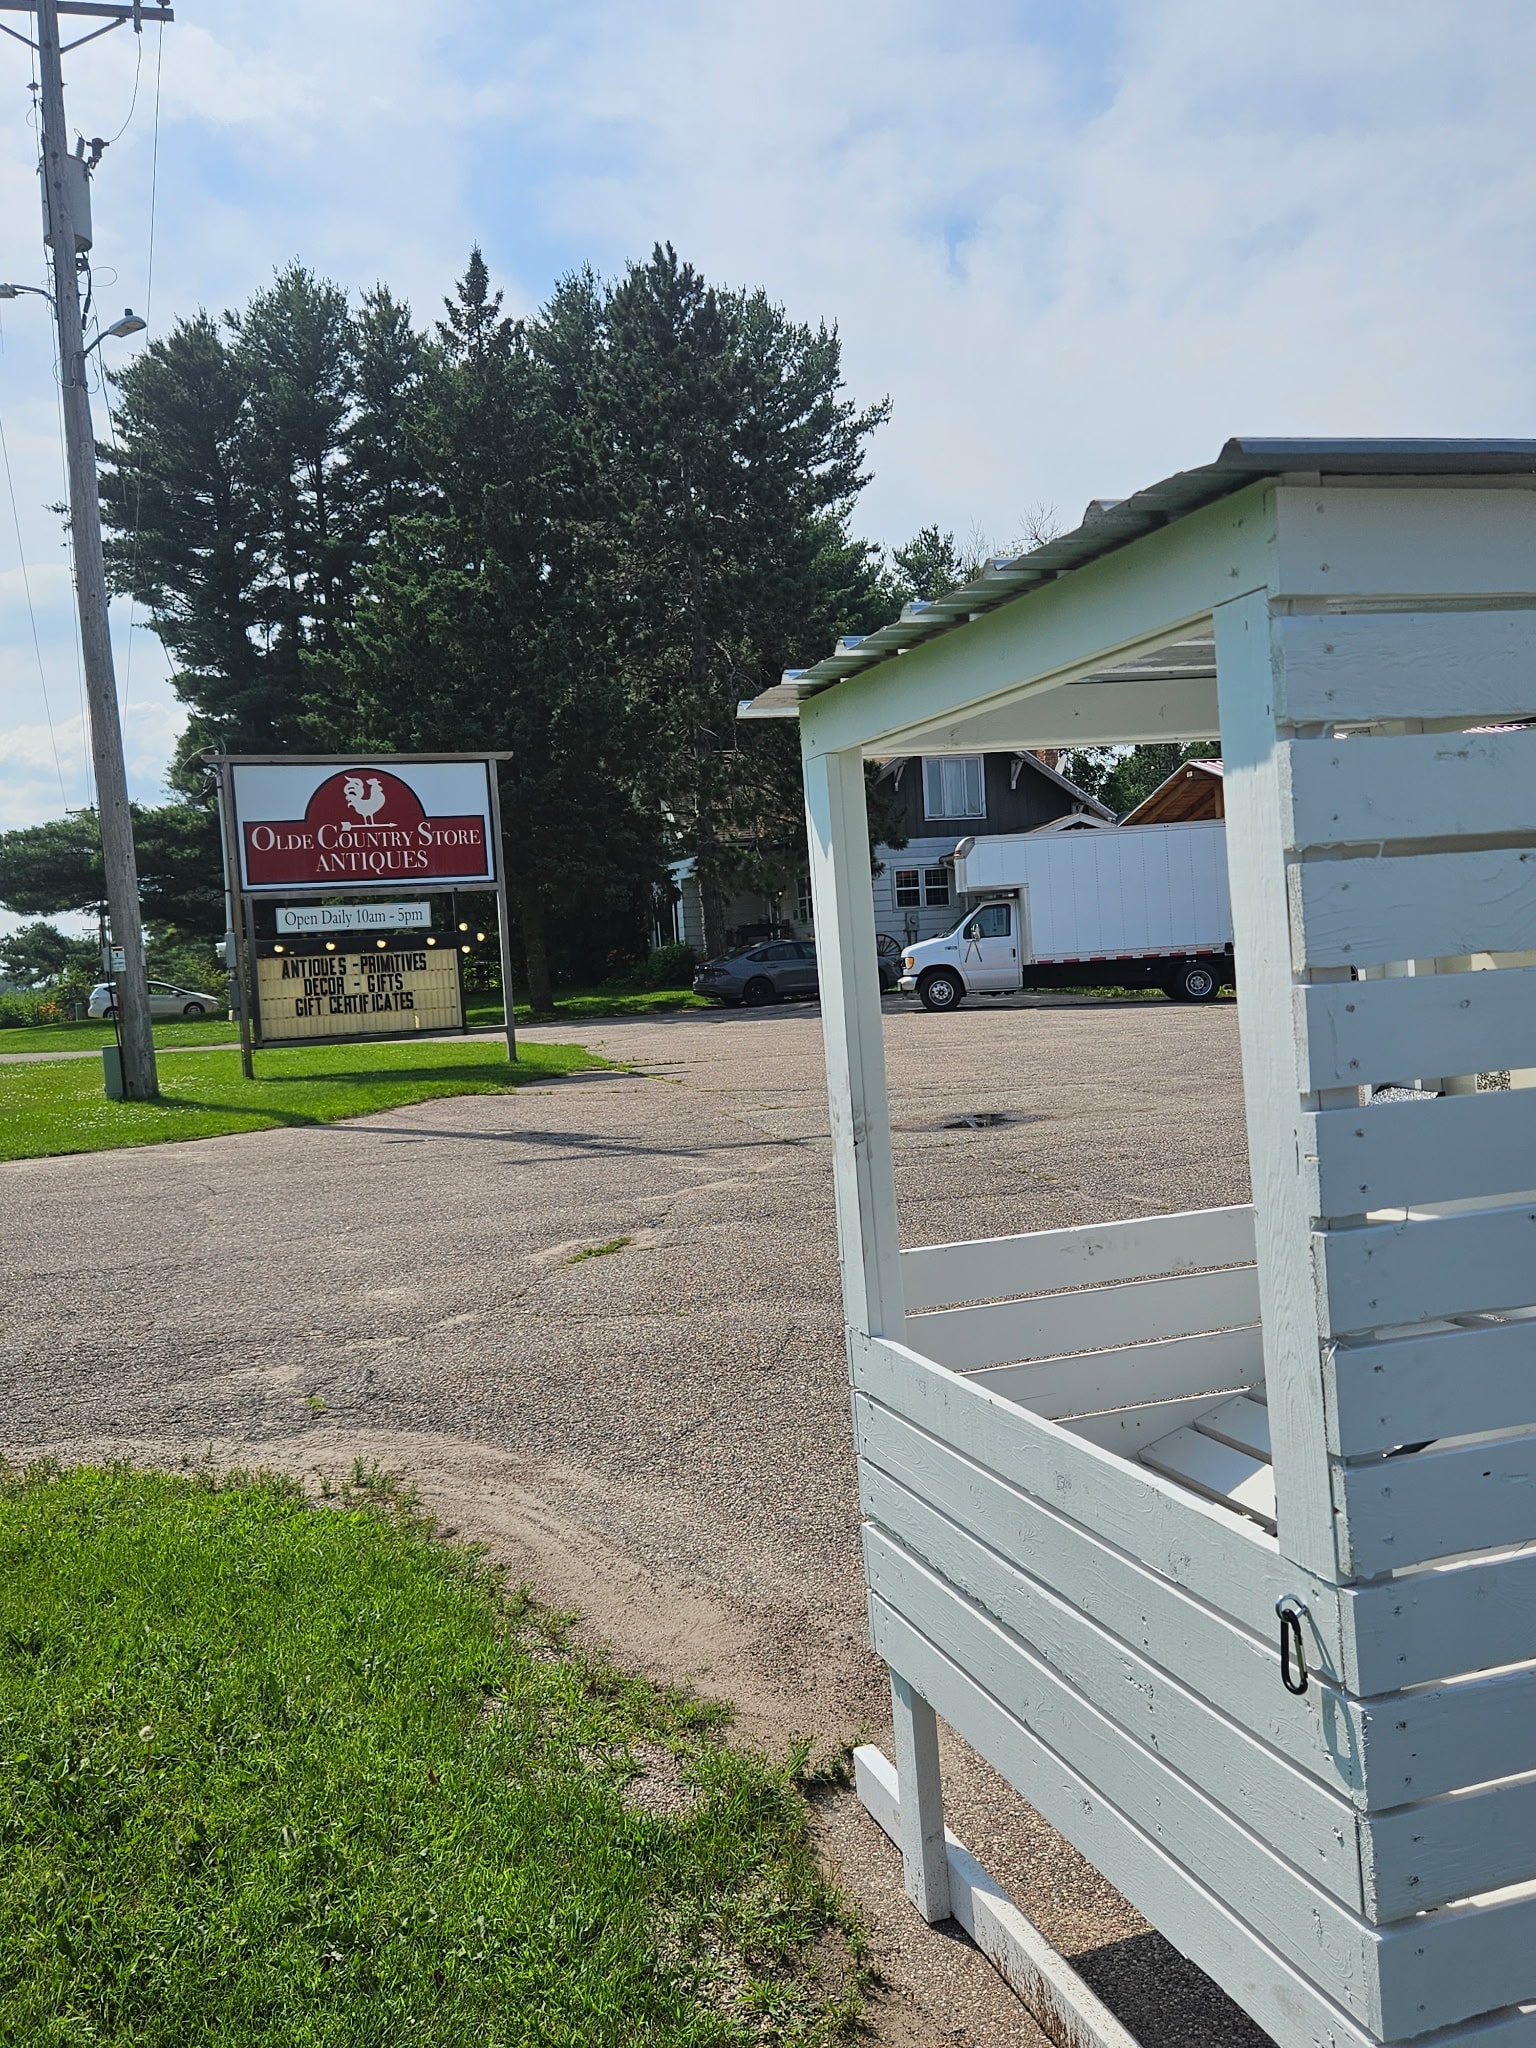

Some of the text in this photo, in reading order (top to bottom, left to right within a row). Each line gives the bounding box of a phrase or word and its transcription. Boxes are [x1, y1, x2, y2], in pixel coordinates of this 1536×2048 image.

[317, 824, 415, 850] COUNTRY
[417, 821, 481, 847] STORE
[316, 850, 428, 874] ANTIQUES
[284, 911, 318, 929] Open
[321, 909, 352, 927] Daily
[356, 908, 386, 924] 10am
[397, 907, 423, 925] 5pm
[303, 977, 345, 996] DECOR
[367, 973, 403, 993] GIFTS
[296, 992, 414, 1016] GIFT CERTIFICATES
